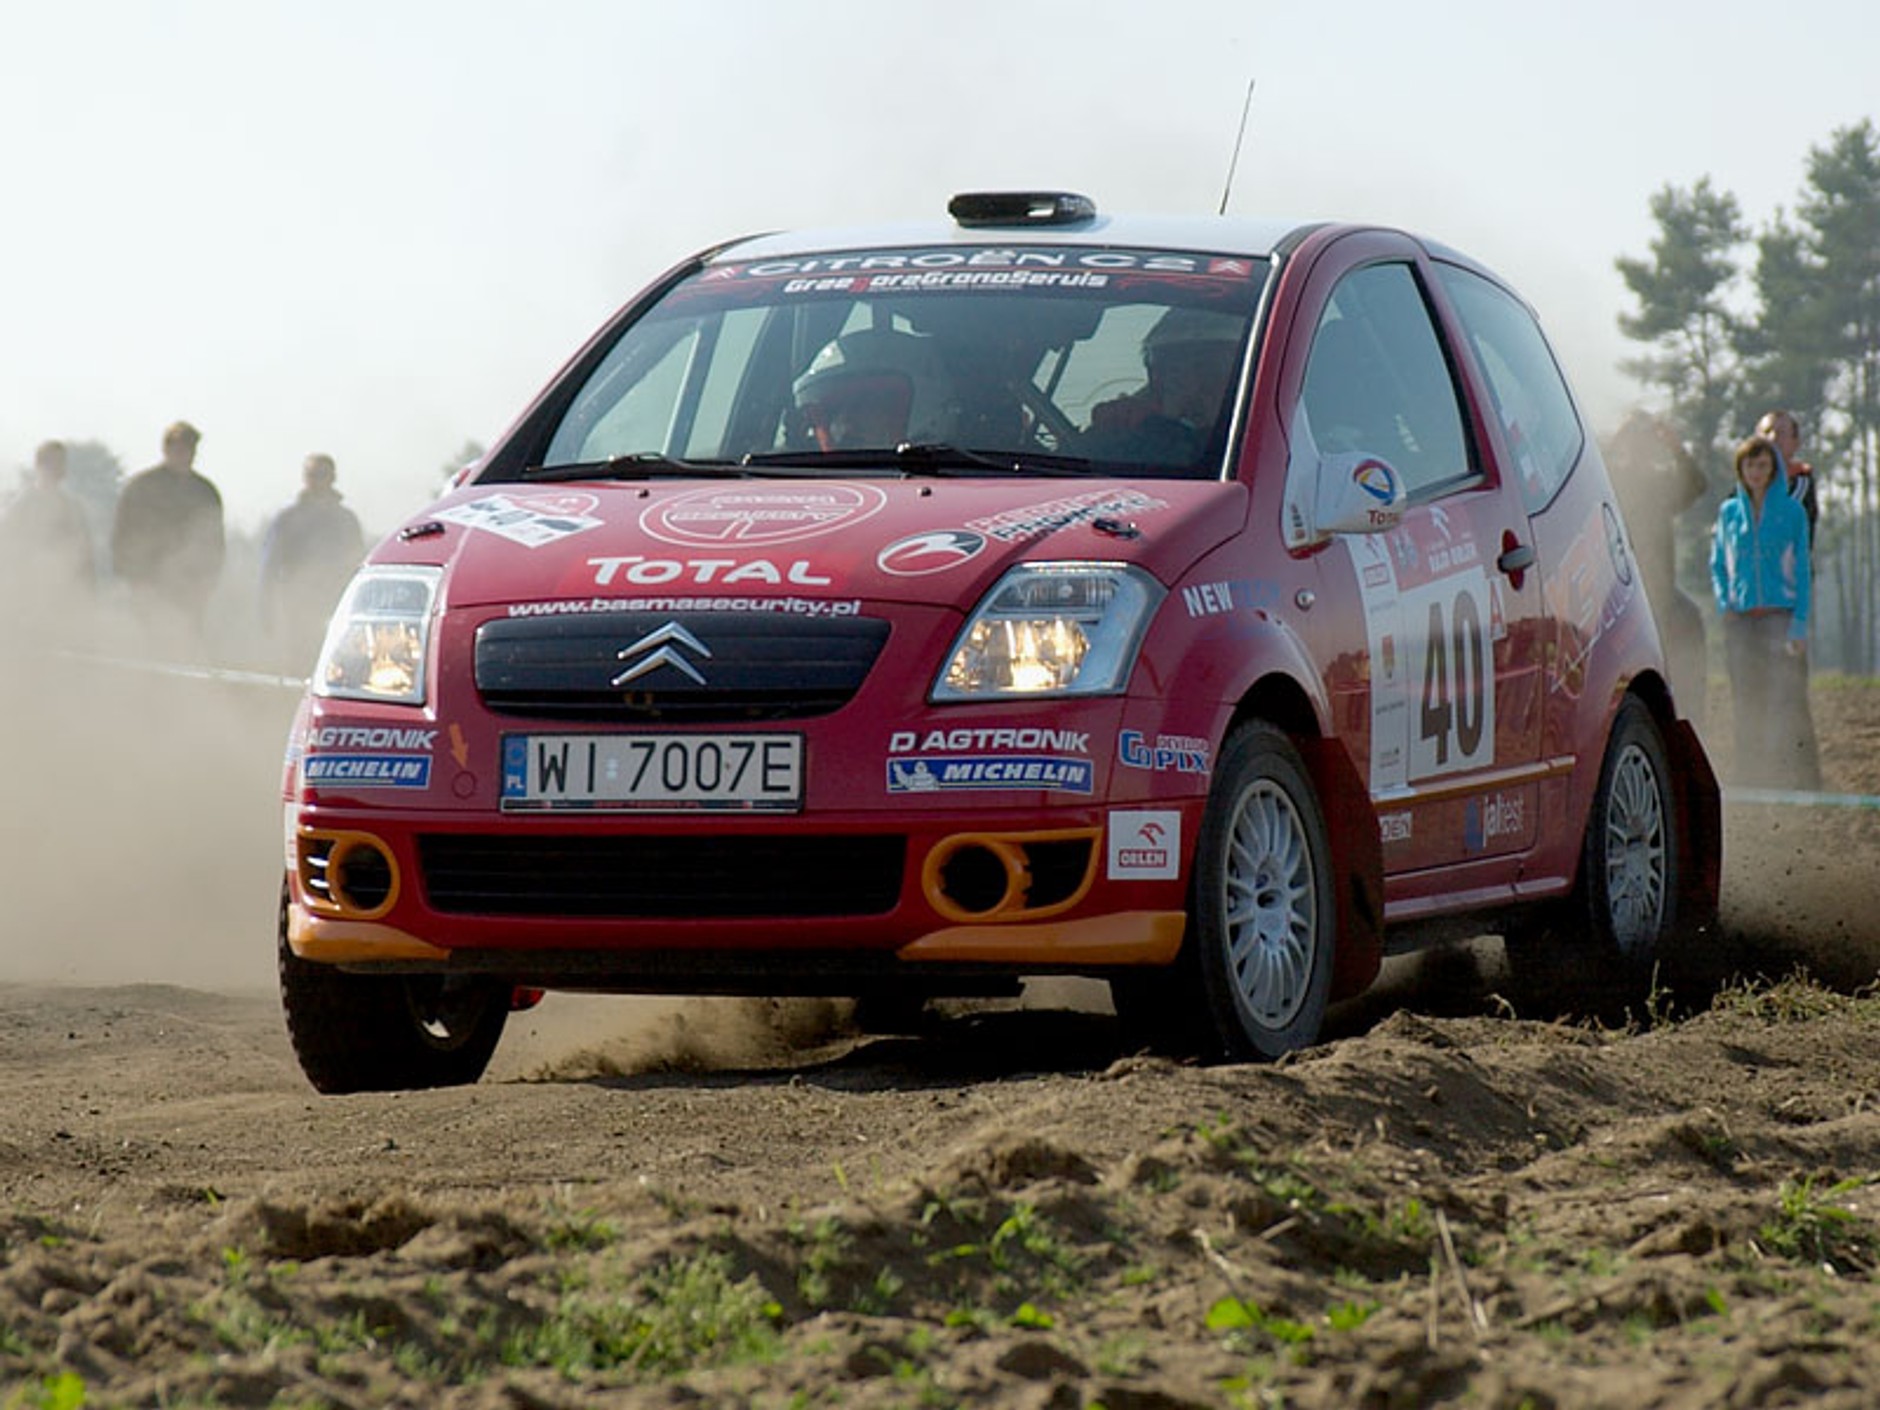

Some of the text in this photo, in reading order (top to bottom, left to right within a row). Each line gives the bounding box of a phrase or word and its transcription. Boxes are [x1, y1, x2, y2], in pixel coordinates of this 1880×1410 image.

[1079, 253, 1196, 272] C2
[587, 556, 831, 585] TOTAL
[508, 597, 862, 618] www.basmasecurity.pl
[1182, 582, 1234, 617] NEW
[1421, 590, 1484, 766] 40
[308, 761, 423, 779] MICHELIN
[538, 741, 793, 793] WI 7007E
[942, 762, 1086, 784] MICHELIN
[507, 775, 524, 789] PL
[1120, 851, 1165, 866] ORLEN
